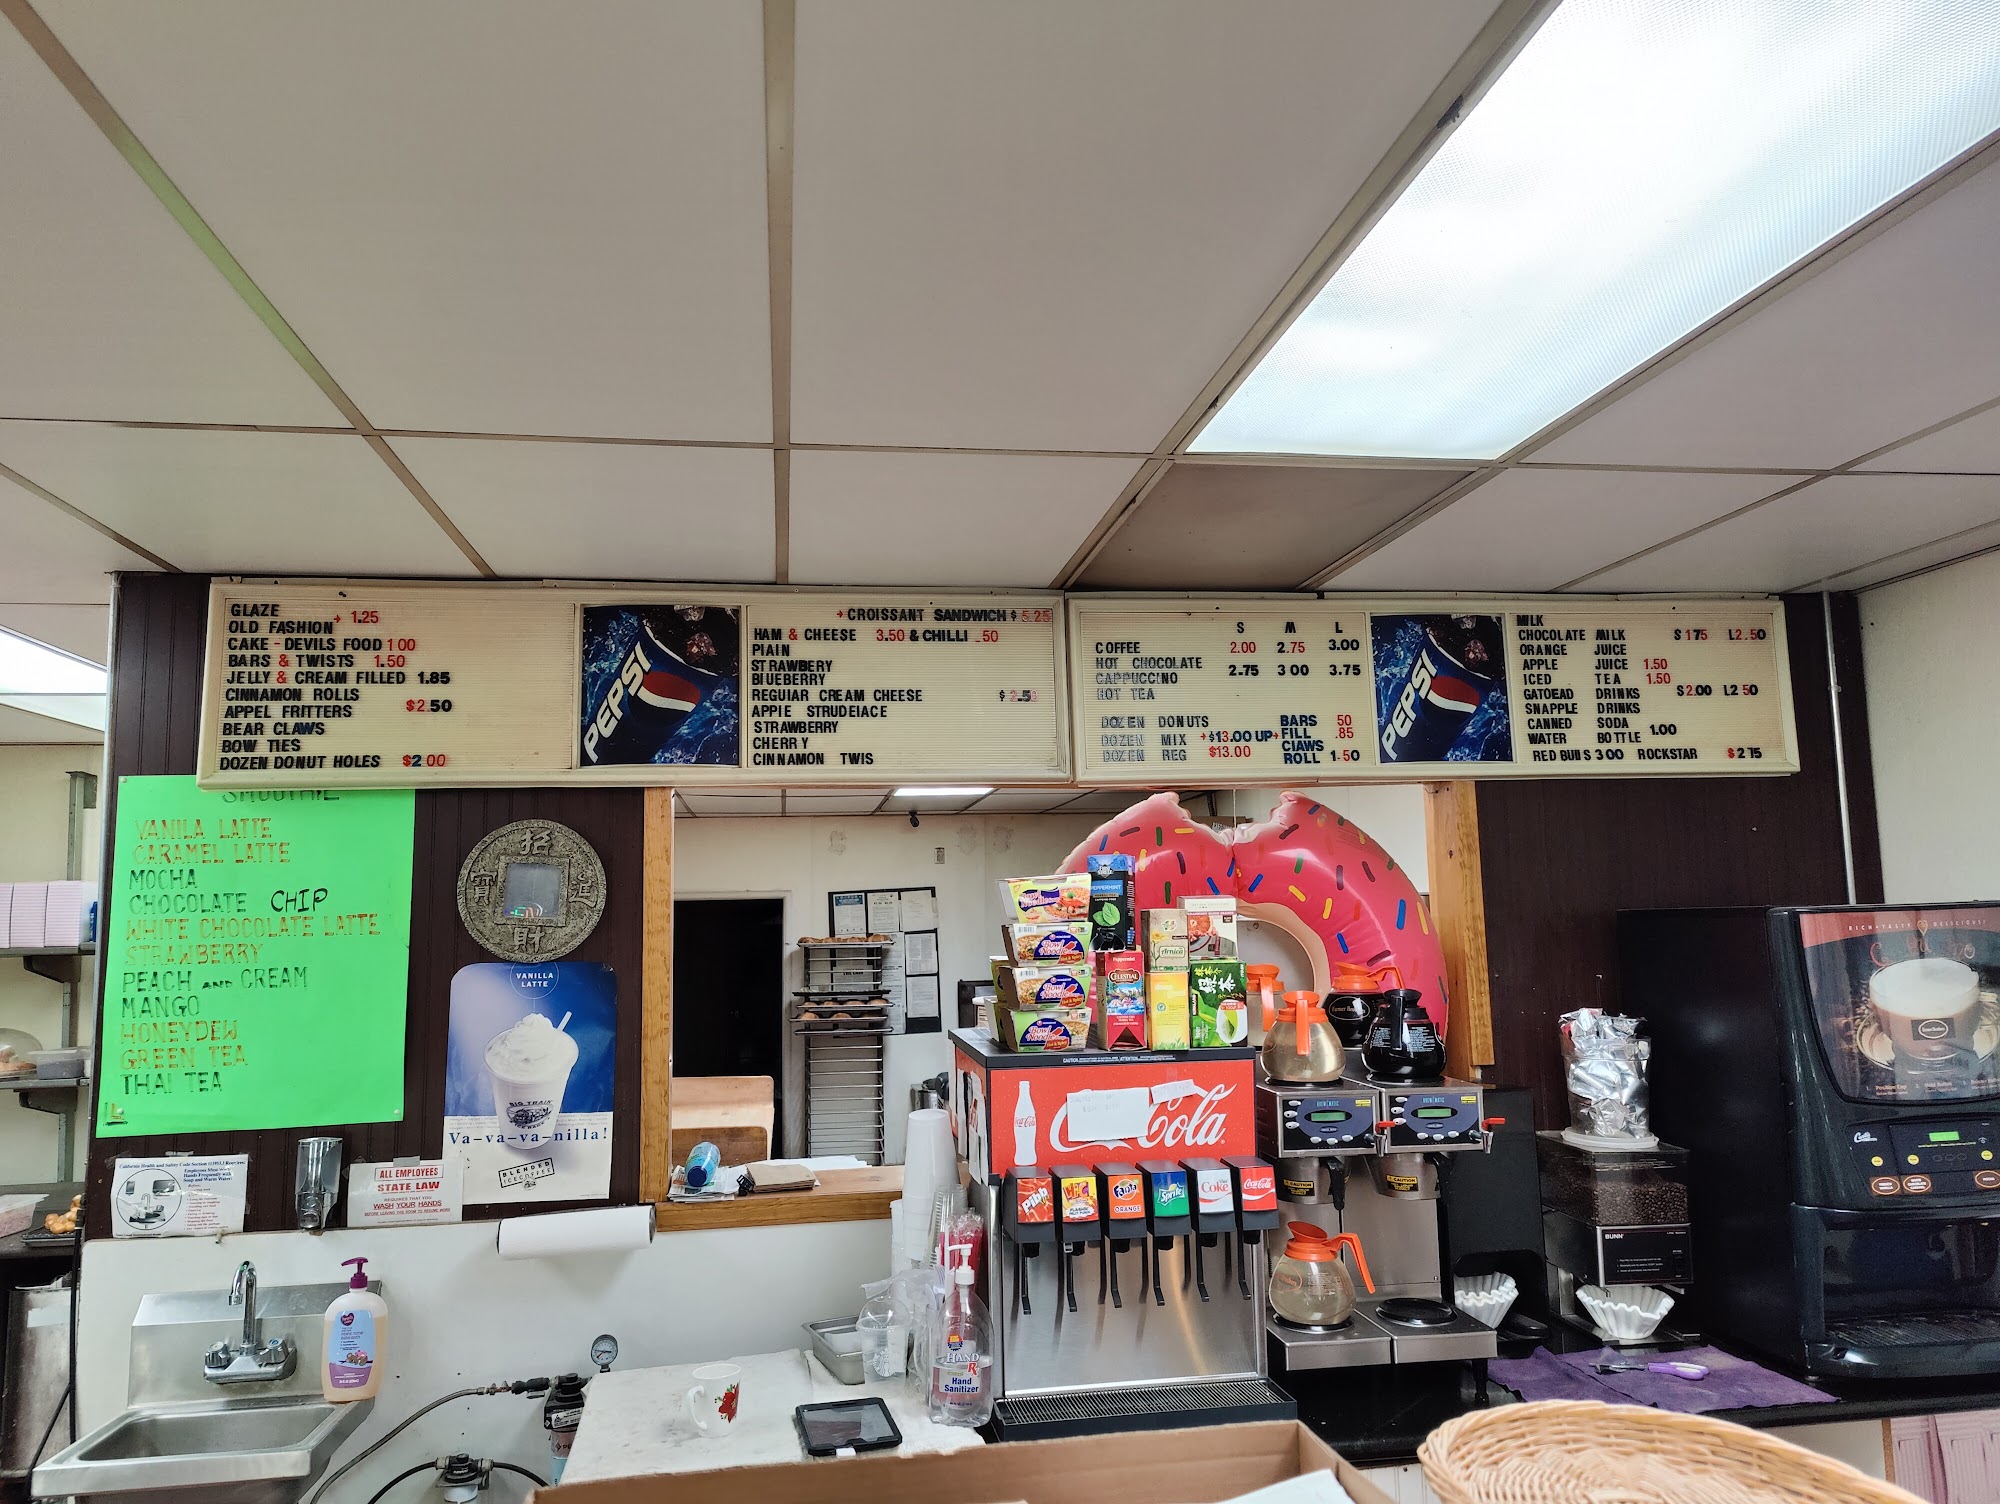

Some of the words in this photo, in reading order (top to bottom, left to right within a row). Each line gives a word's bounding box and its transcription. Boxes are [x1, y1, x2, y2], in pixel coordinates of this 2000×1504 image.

[231, 604, 280, 616] GLAZE
[847, 608, 924, 621] CROISSANT
[934, 608, 1007, 622] SANDWICH
[351, 611, 379, 623] 1.25
[1516, 615, 1544, 626] MILK
[228, 621, 259, 634] OLD
[269, 621, 333, 634] FASHION
[1237, 621, 1245, 634] S
[1335, 621, 1343, 634] L
[754, 628, 782, 641] HAM
[789, 628, 798, 641] &
[804, 628, 856, 641] CHEESE
[876, 628, 904, 641] 3.50
[910, 629, 919, 642] &
[922, 630, 968, 642] CHILLI
[1518, 629, 1586, 641] CHOCOLATE
[1595, 629, 1626, 641] MILK
[228, 637, 269, 651] CAKE
[285, 637, 336, 651] DEVILS
[344, 638, 382, 651] FOOD
[1095, 641, 1141, 654] COFFEE
[1230, 641, 1257, 654] 2.00
[1277, 641, 1306, 654] 2.75
[1328, 639, 1360, 651] 3.00
[1519, 644, 1568, 655] ORANGE
[1594, 644, 1627, 656] JUICE
[228, 654, 271, 667] BARS
[278, 654, 289, 667] &
[296, 654, 354, 667] TWISTS
[374, 654, 405, 667] 1.50
[1096, 657, 1119, 669] HOT
[1132, 657, 1203, 669] CHOCOLATE
[1228, 664, 1259, 676] 2.75
[1329, 664, 1361, 676] 3.75
[1522, 659, 1558, 671] APPLE
[1595, 659, 1629, 670] JUICE
[1643, 658, 1668, 670] 1.50
[226, 671, 270, 684] JELLY
[276, 671, 287, 684] &
[295, 671, 347, 684] CREAM
[356, 671, 405, 684] FILLED
[417, 671, 450, 684] 1.85
[1095, 672, 1178, 685] CAPPUCCINO
[1523, 673, 1552, 685] ICED
[1595, 673, 1622, 685] TEA
[1646, 672, 1671, 684] 1.50
[225, 688, 301, 701] CINNAMON
[313, 688, 360, 701] ROLLS
[819, 690, 865, 702] CREAM
[873, 689, 923, 702] CHEESE
[1097, 688, 1121, 700] HOT
[1131, 688, 1155, 700] TEA
[1596, 688, 1640, 700] DRINKS
[406, 699, 452, 712] $2.50
[583, 641, 653, 763] PEPSI
[1381, 648, 1439, 761] PEPSI
[1525, 703, 1578, 715] SNAPPLE
[1597, 702, 1641, 714] DRINKS
[224, 705, 272, 719] APPEL
[282, 705, 353, 718] FRITTERS
[754, 721, 839, 734] STRAWBERRY
[1101, 716, 1145, 728] DOZEN
[1158, 715, 1209, 728] DONUTS
[1280, 715, 1318, 727] BARS
[1337, 714, 1352, 726] 50
[1527, 718, 1572, 730] CANNED
[1597, 717, 1629, 729] SODA
[1649, 724, 1677, 735] 1.00
[222, 722, 264, 736] BEAR
[273, 722, 325, 735] CLAWS
[753, 737, 809, 749] CHERRY
[1101, 734, 1145, 747] DOZEN
[1161, 734, 1187, 746] MIX
[1208, 730, 1252, 743] $13.00
[1255, 730, 1274, 742] UP
[1281, 727, 1312, 739] FILL
[1335, 727, 1354, 739] .85
[1527, 732, 1567, 744] WATER
[1597, 732, 1642, 744] BOTTLE
[221, 739, 257, 753] BOW
[267, 738, 301, 752] TIES
[753, 753, 824, 766] CINNAMON
[840, 753, 874, 765] TWIS
[1103, 749, 1145, 762] DOZEN
[1162, 749, 1187, 761] REG
[1208, 745, 1251, 758] $13.00
[1283, 753, 1321, 765] ROLL
[1533, 750, 1557, 762] RED
[1638, 748, 1698, 760] ROCKSTAR
[220, 756, 268, 770] DOZEN
[273, 755, 326, 769] DONUT
[333, 755, 381, 768] HOLES
[218, 818, 272, 839] LATTE
[132, 843, 225, 865] CARAMEL
[234, 842, 291, 864] LATTE
[129, 868, 198, 890] MOCHA
[129, 892, 247, 915] CHOCOLATE
[270, 888, 329, 913] CHIP
[125, 918, 190, 941] WHITE
[200, 916, 314, 939] CHOCOLATE
[324, 913, 381, 937] LATTE
[124, 943, 264, 966] STRAWBERRY
[1161, 947, 1184, 955] Arnica
[122, 971, 192, 993] PEACH
[201, 980, 233, 990] AND
[240, 966, 308, 989] CREAM
[516, 972, 553, 980] VANILLA
[1110, 972, 1138, 980] CELESTIAL
[121, 995, 200, 1019] MANGO
[120, 1020, 239, 1044] HONEYDEW
[120, 1047, 196, 1070] GREEN
[209, 1045, 248, 1067] TEA
[120, 1073, 172, 1095] THAI
[184, 1072, 223, 1092] TEA
[380, 1169, 393, 1179] ALL
[395, 1167, 439, 1178] EMPLOYEES
[502, 1161, 550, 1177] BLENDED
[377, 1182, 412, 1192] STATE
[415, 1181, 440, 1190] LAW
[1113, 1183, 1137, 1198] Fanta
[1201, 1181, 1229, 1193] Coke
[1021, 1187, 1049, 1214] Pibb
[1161, 1188, 1183, 1202] Sprite
[1114, 1205, 1141, 1213] ORANGE
[947, 1353, 980, 1363] HAND
[952, 1377, 972, 1385] Hand
[944, 1384, 979, 1393] Sanitizer
